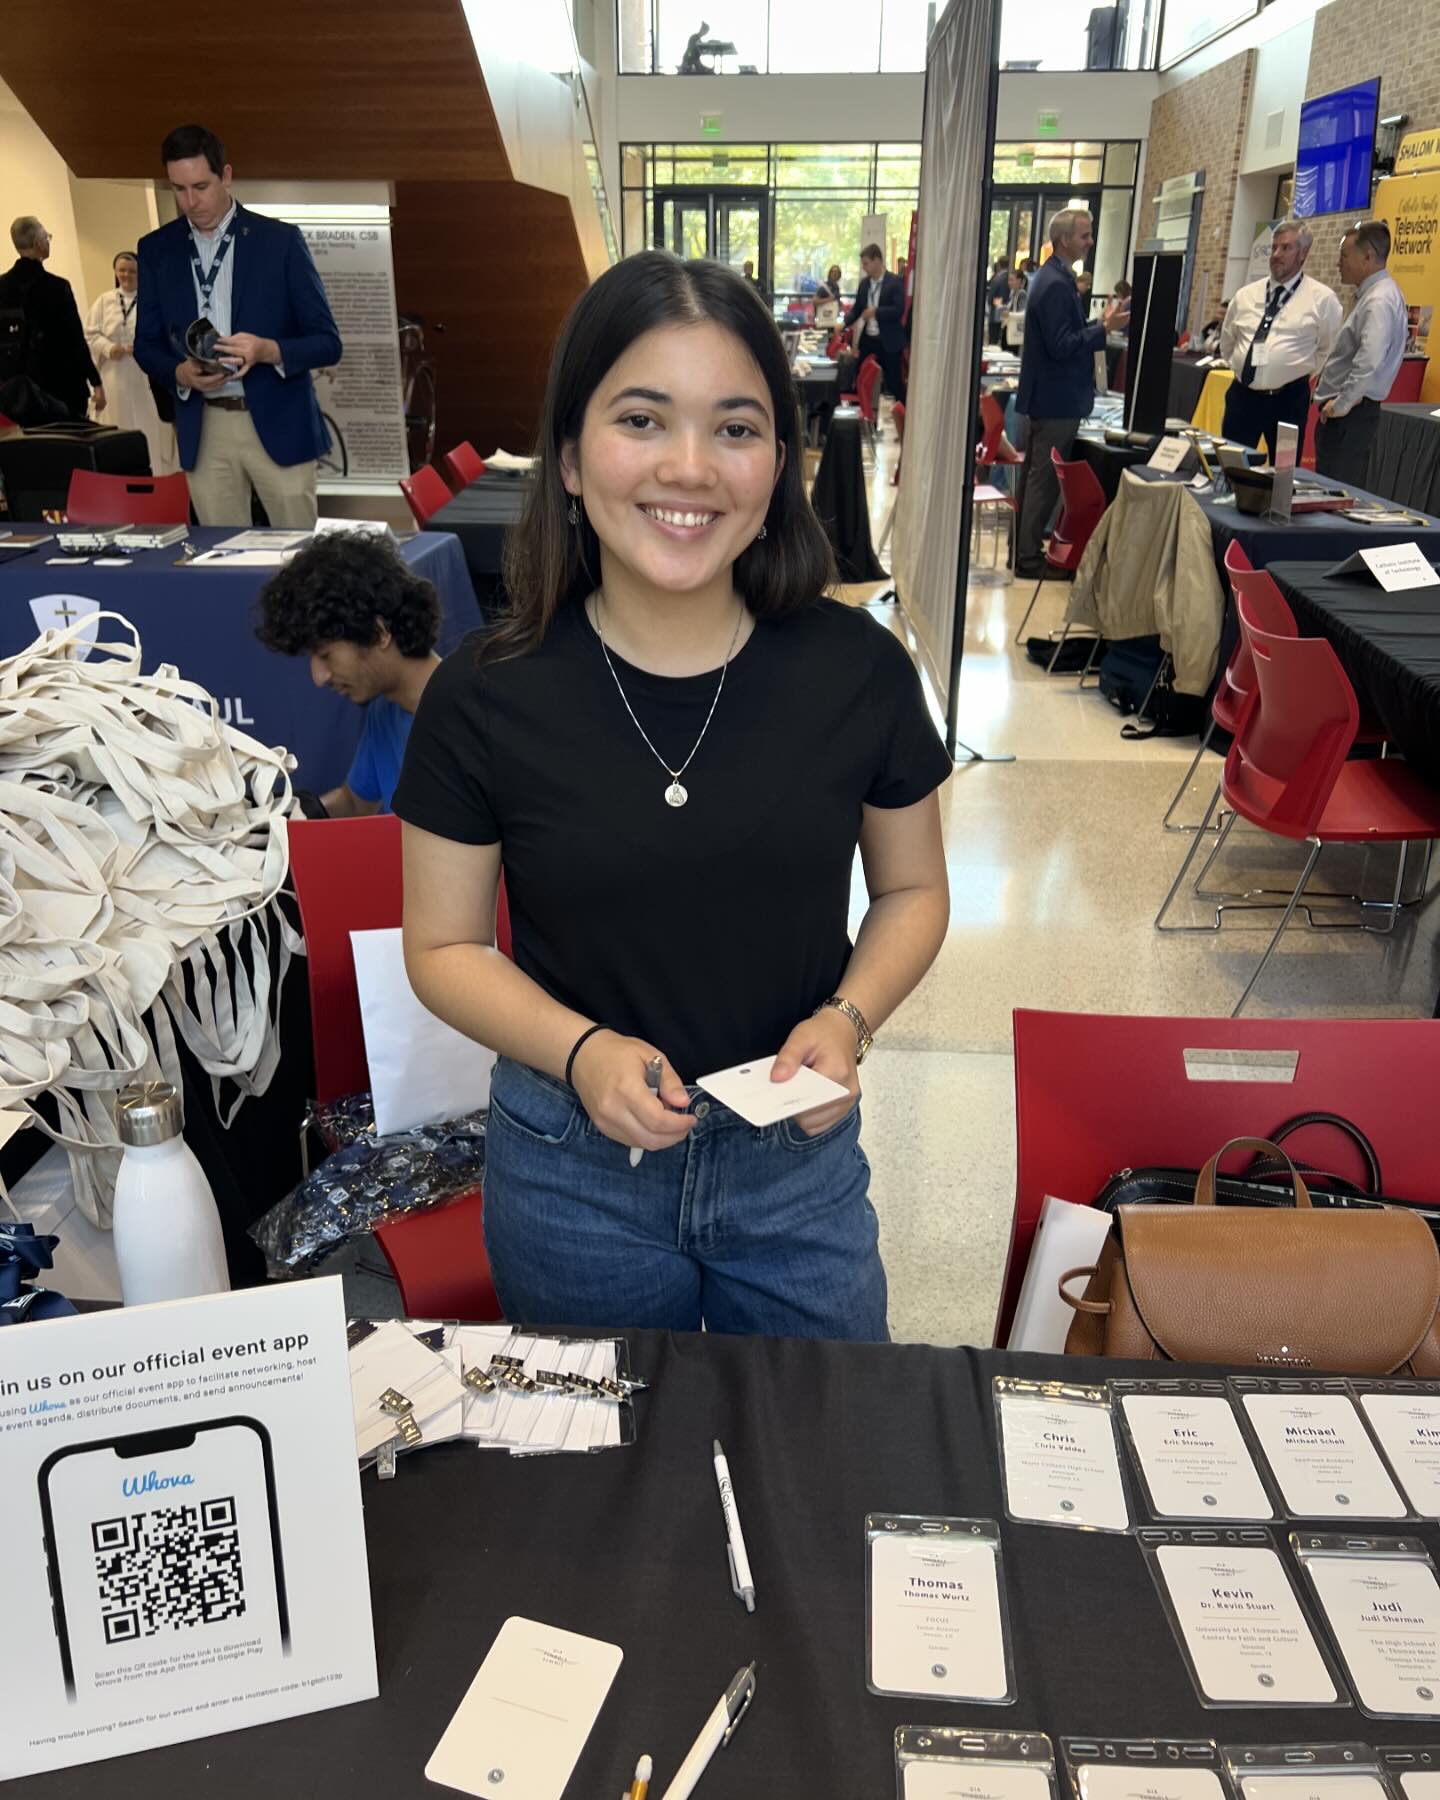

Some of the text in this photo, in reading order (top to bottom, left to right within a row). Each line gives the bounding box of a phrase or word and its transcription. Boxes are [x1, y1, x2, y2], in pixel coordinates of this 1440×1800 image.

[1400, 140, 1434, 161] SHALOM
[1395, 215, 1438, 235] Television
[359, 231, 378, 240] CSB
[1392, 235, 1432, 255] Network
[27, 1375, 52, 1391] us
[59, 1370, 85, 1386] on
[92, 1363, 126, 1380] our
[133, 1347, 205, 1373] official
[212, 1338, 267, 1360] event
[273, 1333, 309, 1352] app
[29, 1400, 66, 1414] Whova
[69, 1398, 81, 1406] as
[83, 1394, 99, 1404] our
[102, 1387, 136, 1400] official
[138, 1383, 164, 1393] event
[166, 1380, 184, 1390] app
[186, 1377, 196, 1385] to
[199, 1370, 239, 1384] facilitate
[242, 1361, 294, 1376] networking,
[297, 1357, 317, 1367] host
[6, 1420, 32, 1431] event
[77, 1404, 122, 1419] distribute
[125, 1394, 181, 1410] documents,
[183, 1390, 200, 1400] and
[203, 1385, 226, 1396] send
[228, 1373, 304, 1393] announcements!
[1173, 1429, 1198, 1438] Eric
[1285, 1427, 1336, 1436] Michael
[1043, 1432, 1076, 1443] Chris
[1034, 1442, 1056, 1450] Chris
[122, 1470, 195, 1497] Whova
[909, 1577, 963, 1590] Thomas
[904, 1590, 970, 1601] Thomas Wurtz
[1211, 1588, 1254, 1599] Kevin
[1245, 1602, 1275, 1610] Stuart
[1372, 1601, 1402, 1612] Judi
[1360, 1614, 1424, 1624] Judi Sherman
[94, 1669, 115, 1679] Scan
[116, 1666, 132, 1675] this
[134, 1662, 146, 1671] QR
[148, 1658, 167, 1668] code
[169, 1655, 181, 1664] for
[183, 1652, 196, 1661] the
[197, 1648, 211, 1658] link
[223, 1637, 262, 1652] download
[94, 1646, 263, 1688] Whova from the App Store and Google Play
[29, 1737, 56, 1747] Having
